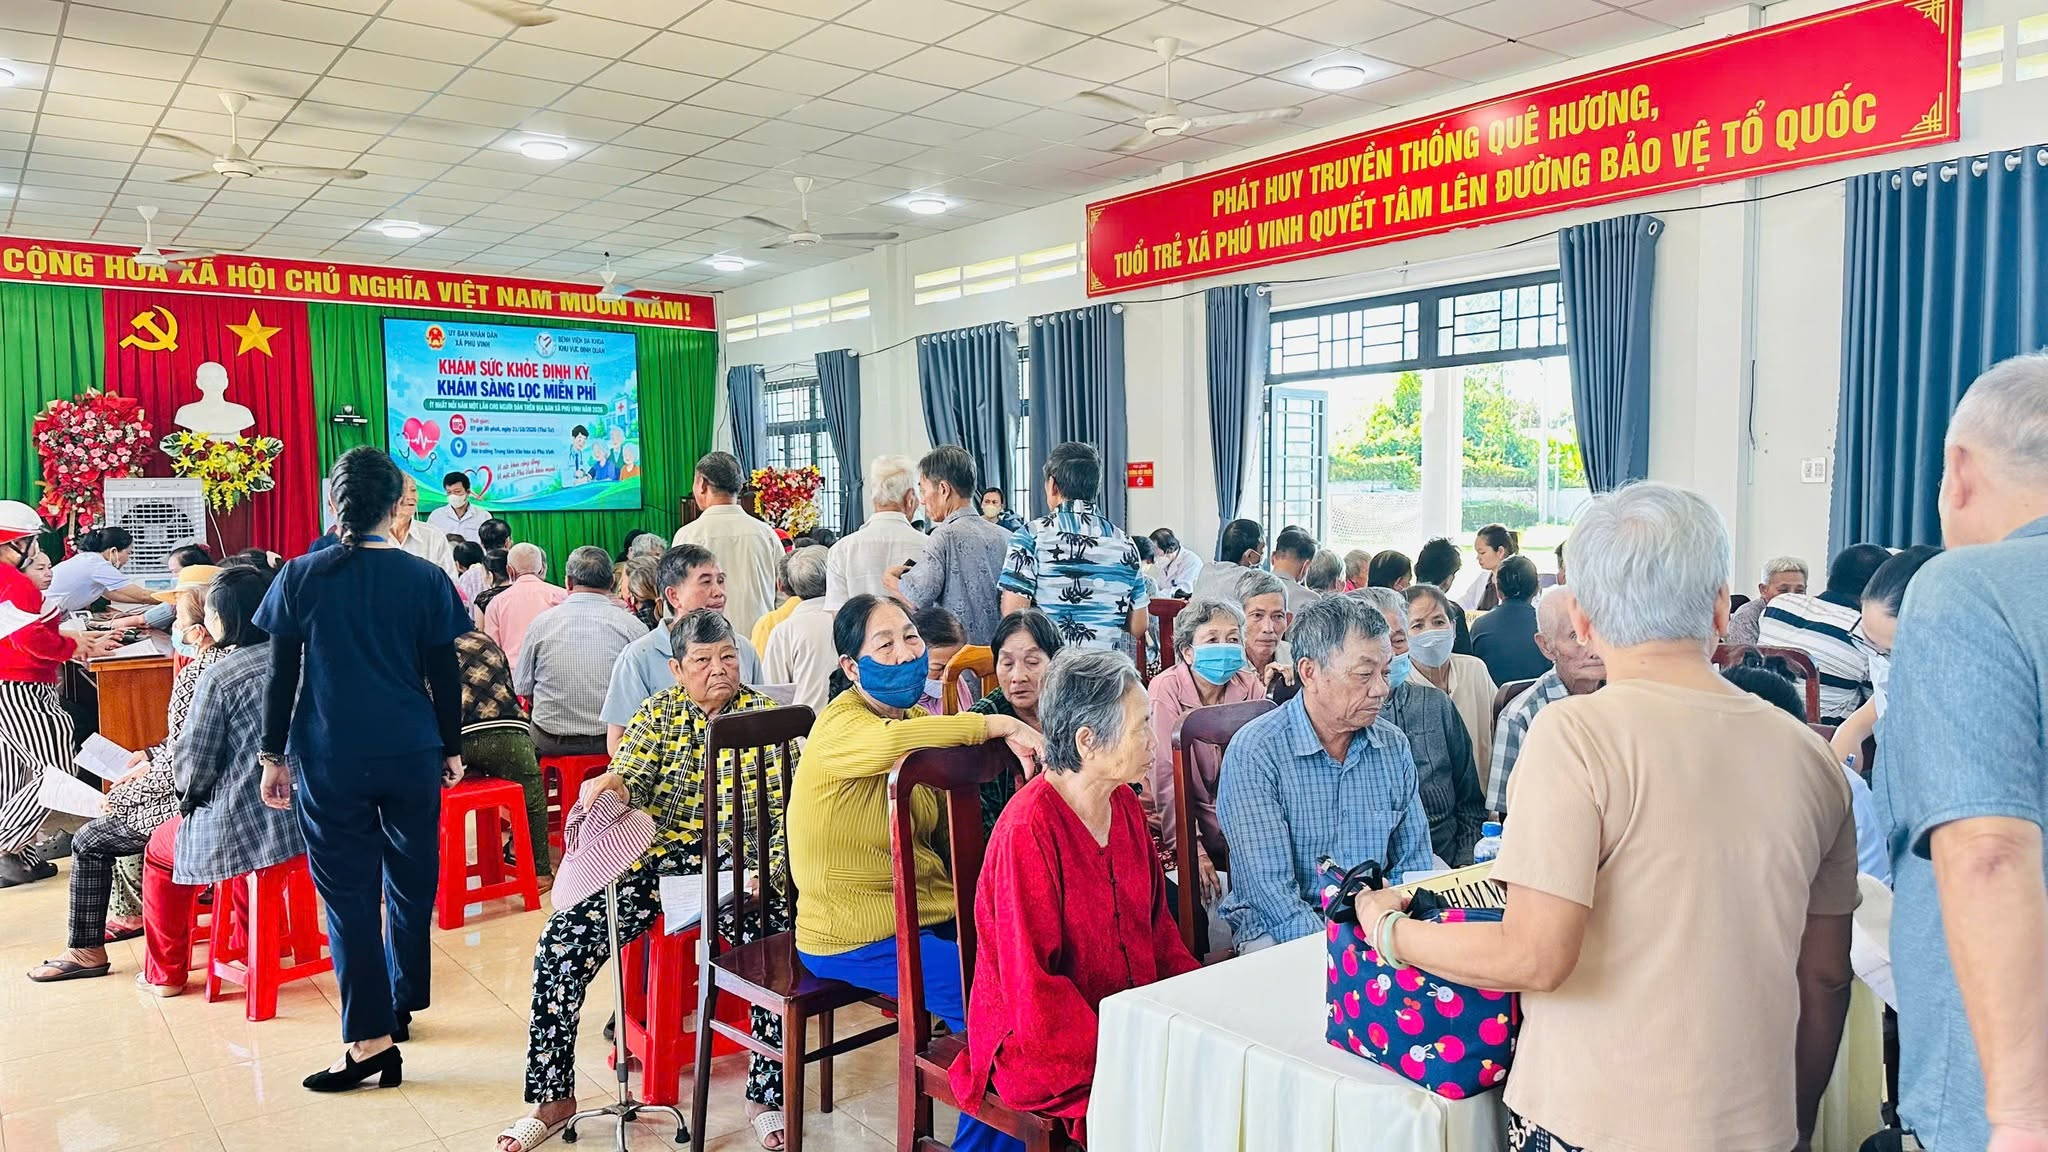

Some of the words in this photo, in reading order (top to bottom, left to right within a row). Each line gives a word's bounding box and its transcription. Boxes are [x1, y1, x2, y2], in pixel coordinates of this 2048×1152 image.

[1213, 177, 1259, 218] PHÁT
[1265, 169, 1303, 204] HUY
[1309, 140, 1392, 194] TRUYỀN
[1399, 123, 1480, 172] THỐNG
[1487, 106, 1539, 152] QUÊ
[1549, 84, 1659, 139] HƯƠNG,
[1114, 238, 1148, 279] TUỔI
[1152, 233, 1182, 271] TRẺ
[1187, 230, 1210, 264] XÃ
[1215, 221, 1252, 259] PHÚ
[1257, 215, 1303, 249] VINH
[1309, 191, 1375, 241] QUYẾT
[1382, 182, 1432, 225] TÂM
[1441, 172, 1487, 215] LÊN
[1495, 146, 1590, 203] ĐƯỜNG
[1601, 130, 1661, 181] BẢO
[1671, 119, 1711, 172] VỆ
[1721, 100, 1766, 158] TỔ
[1775, 83, 1878, 151] QUỐC
[3, 245, 94, 280] CỘNG
[105, 252, 169, 282] HÒA
[178, 258, 219, 286] XÃ
[227, 262, 276, 294] HỘI
[285, 266, 341, 295] CHỦ
[349, 273, 431, 302] NGHĨA
[437, 279, 489, 310] VIỆT
[497, 286, 552, 311] NAM
[634, 296, 692, 322] NĂM!
[437, 377, 477, 397] KHÁM
[481, 378, 514, 399] SÀNG
[518, 383, 540, 402] LỌC
[544, 379, 573, 400] MIỄN
[577, 383, 597, 400] PHÍ
[438, 356, 476, 376] KHÁM
[480, 358, 503, 377] SỨC
[507, 358, 539, 379] KHỎE
[542, 364, 571, 383] ĐỊNH
[1433, 877, 1486, 908] HÁM
